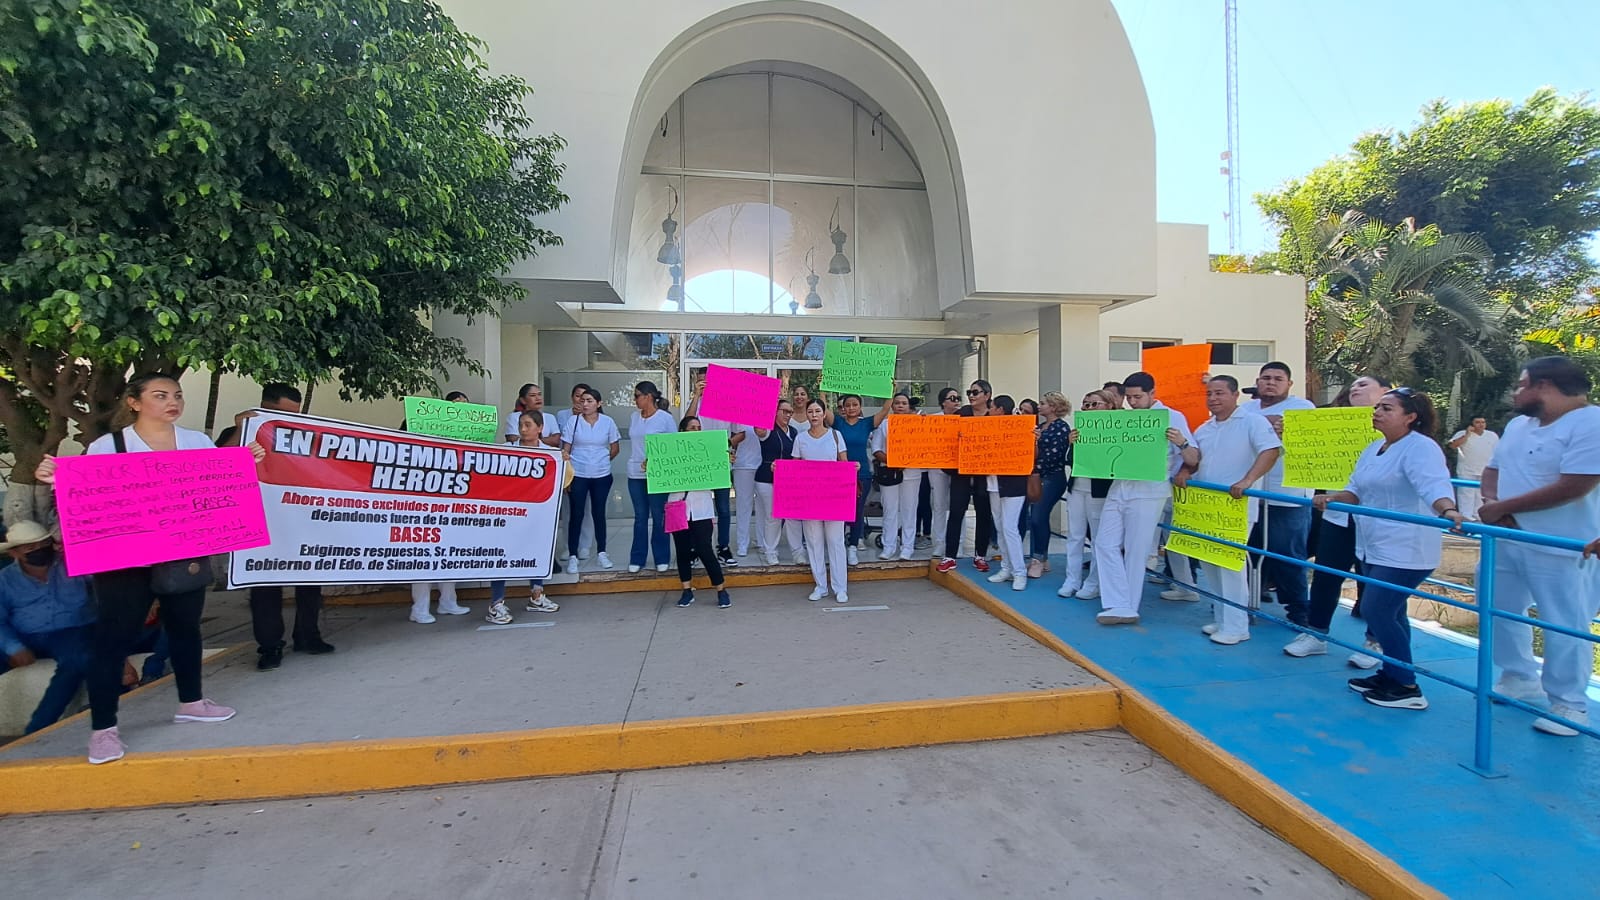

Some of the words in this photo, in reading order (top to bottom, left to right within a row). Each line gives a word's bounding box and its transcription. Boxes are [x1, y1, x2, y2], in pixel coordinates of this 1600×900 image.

[840, 341, 891, 358] EXIGIMOS
[416, 400, 442, 418] SOY
[1077, 414, 1122, 430] Donde
[1126, 414, 1161, 429] están
[646, 437, 668, 455] NO
[676, 439, 706, 453] MAS
[1075, 433, 1117, 445] Nuestras
[1121, 431, 1155, 443] Bases
[1331, 435, 1360, 446] sobre
[273, 426, 315, 456] EN
[318, 432, 459, 471] PANDEMIA
[461, 450, 547, 480] FUIMOS
[1106, 445, 1124, 478] ?
[648, 467, 662, 478] NO
[663, 468, 680, 476] MAS
[684, 461, 729, 474] PROMESAS
[371, 465, 471, 496] HEROES
[192, 495, 238, 511] BASES
[1173, 486, 1187, 505] NO
[281, 491, 325, 506] Ahora
[327, 496, 370, 509] somos
[371, 500, 429, 512] excluidos
[430, 503, 450, 514] por
[451, 503, 478, 514] IMSS
[479, 504, 528, 518] Bienestar,
[311, 509, 388, 523] dejandonos
[390, 513, 421, 525] fuera
[422, 514, 437, 525] de
[438, 514, 450, 526] la
[451, 516, 491, 528] entrega
[493, 516, 506, 528] de
[389, 526, 442, 543] BASES
[300, 544, 362, 558] Exigimos
[363, 546, 432, 559] respuestas,
[434, 546, 447, 557] Sr.
[449, 546, 506, 558] Presidente,
[245, 558, 312, 572] Gobierno
[314, 558, 337, 570] del
[338, 558, 365, 570] Edo.
[367, 559, 384, 570] de
[386, 559, 431, 570] Sinaloa
[432, 561, 439, 571] y
[440, 558, 494, 570] Secretario
[495, 558, 508, 569] de
[509, 557, 538, 569] salud.
